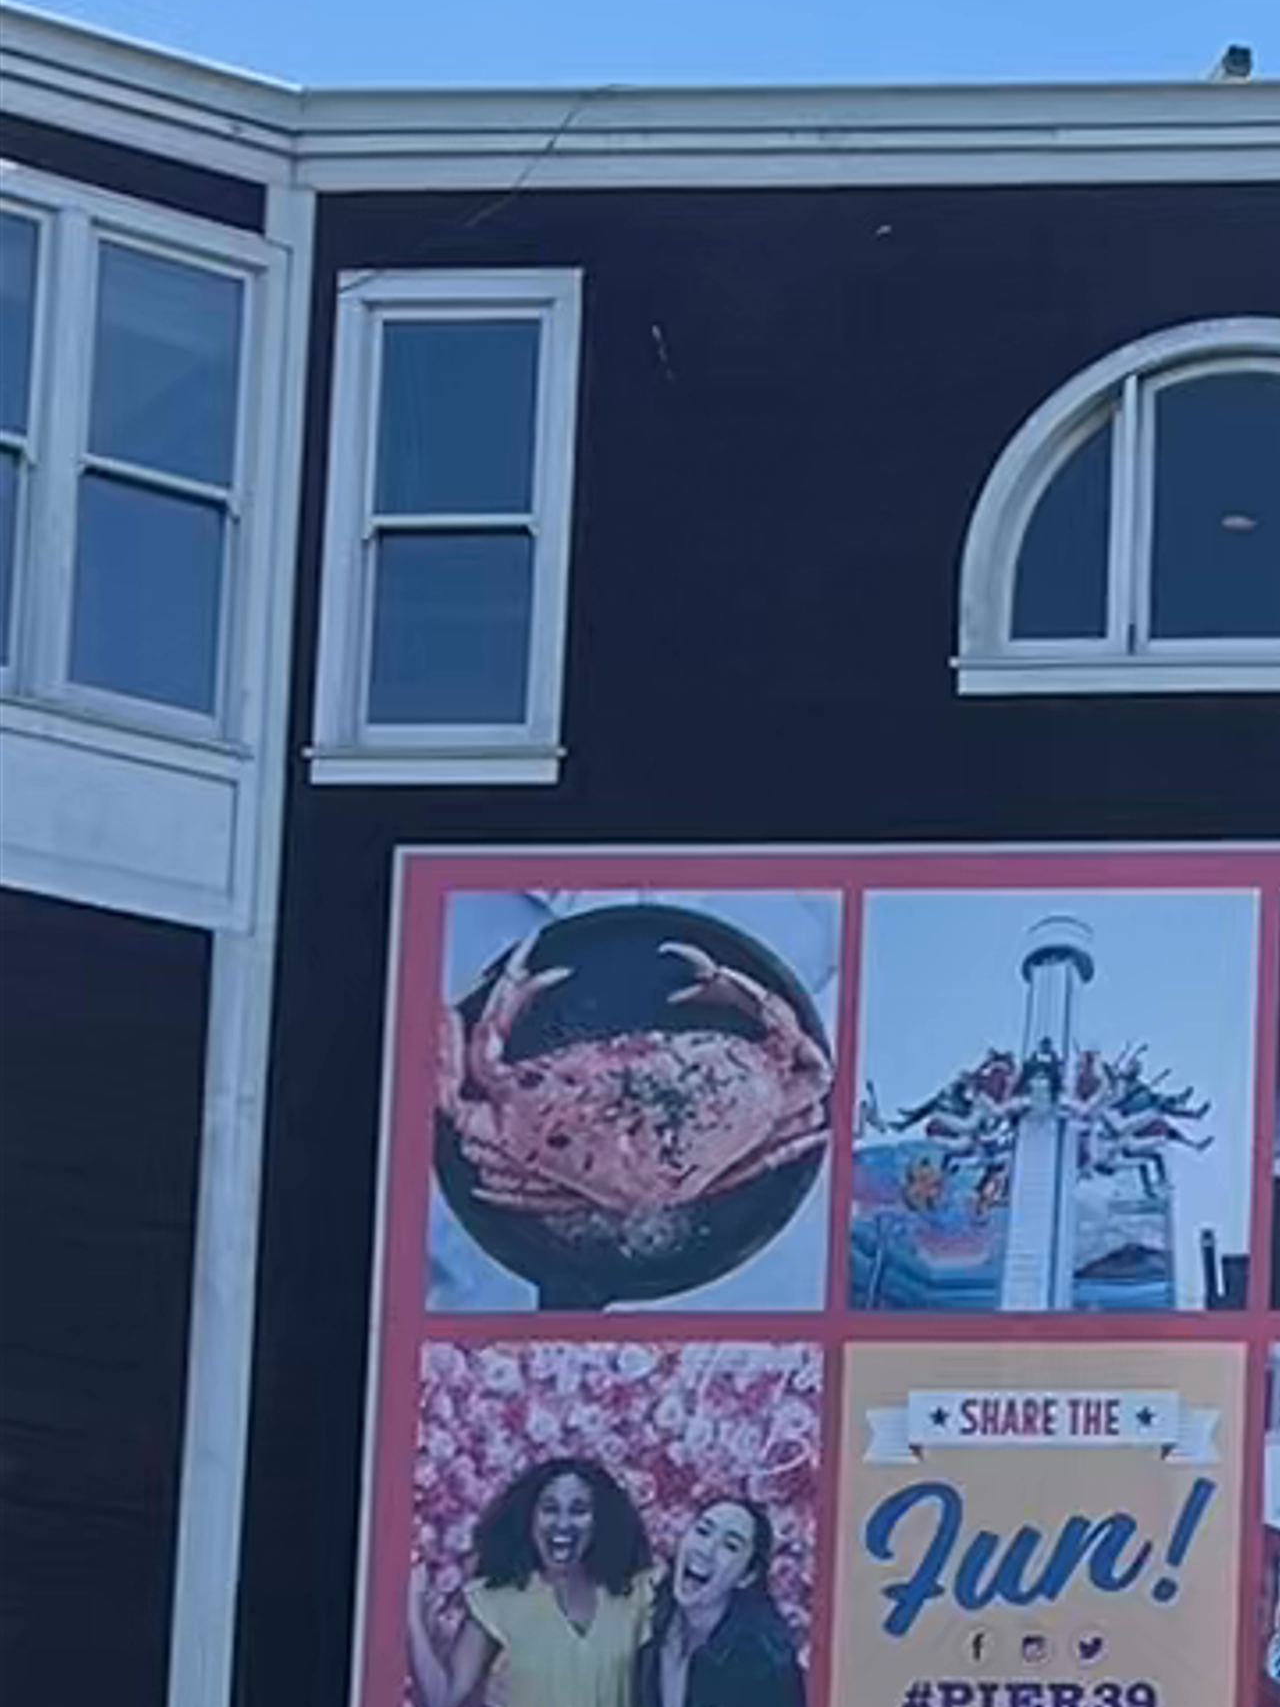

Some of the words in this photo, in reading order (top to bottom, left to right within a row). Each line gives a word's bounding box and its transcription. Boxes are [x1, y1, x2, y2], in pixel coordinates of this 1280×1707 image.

[960, 1398, 1058, 1435] SHARE
[1069, 1398, 1121, 1435] THE
[865, 1477, 1217, 1638] Fun!
